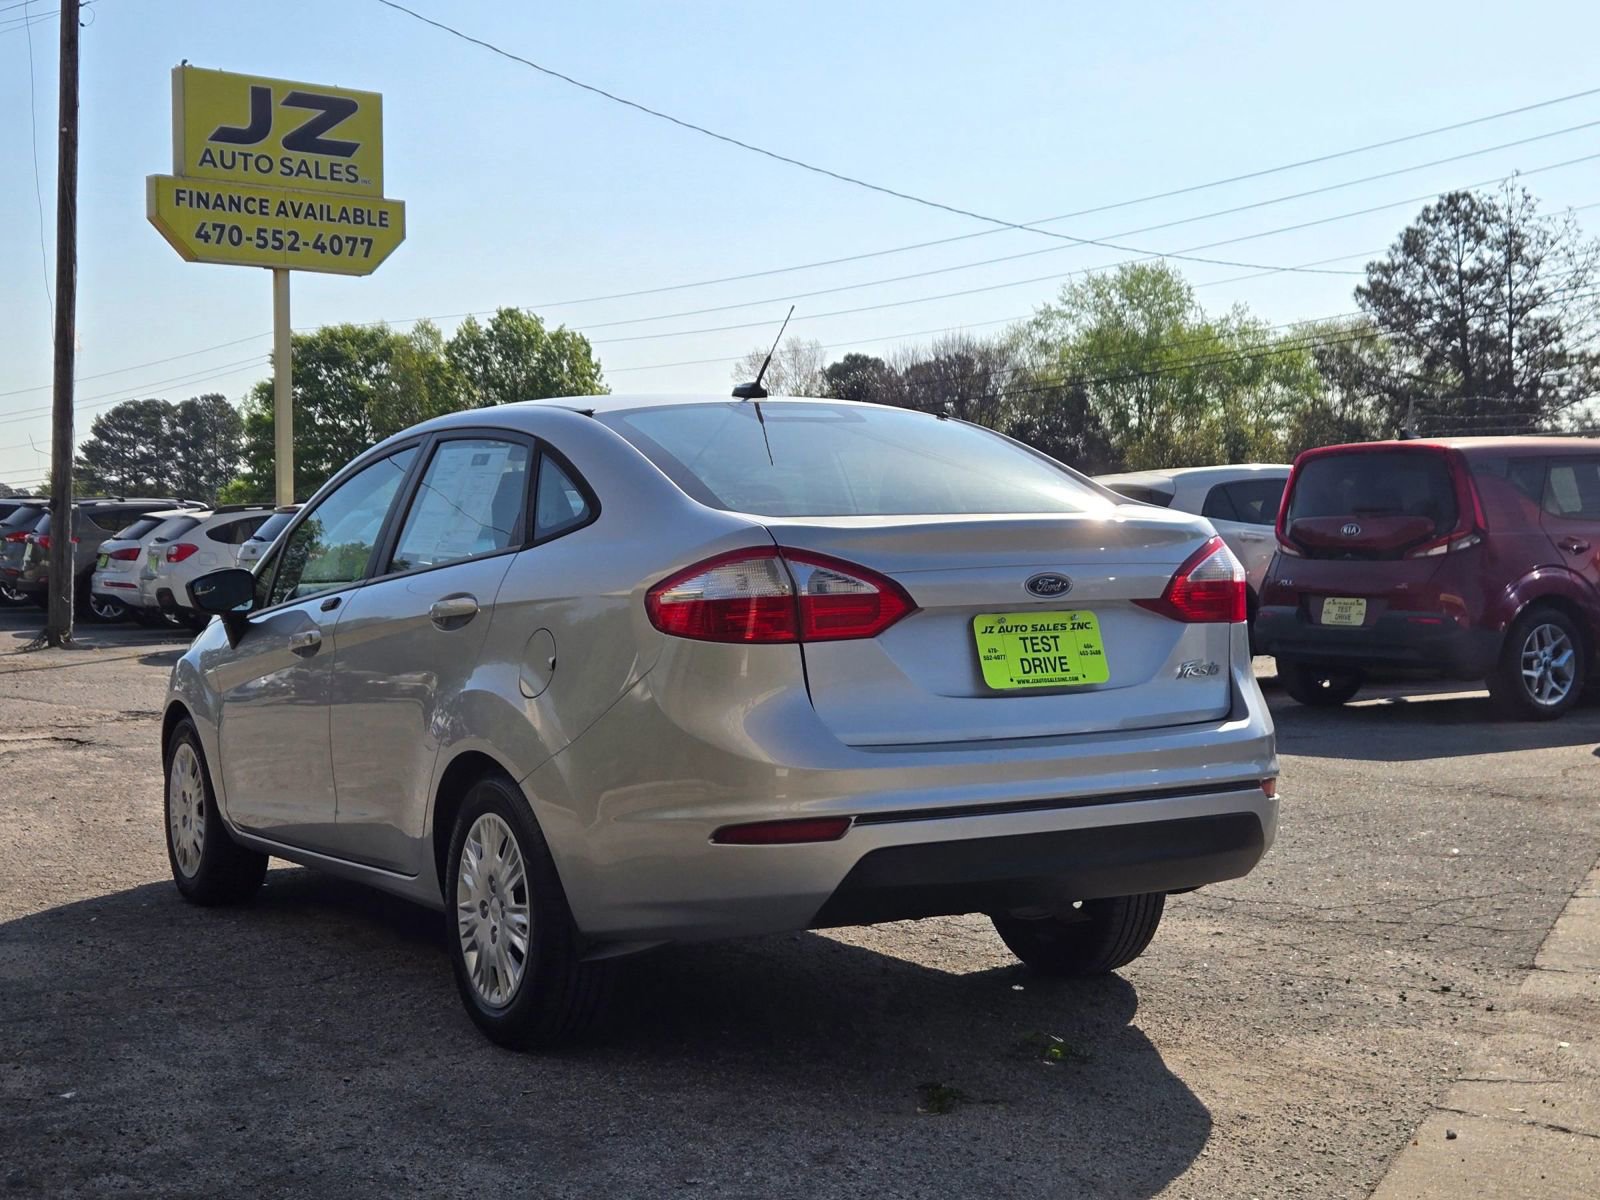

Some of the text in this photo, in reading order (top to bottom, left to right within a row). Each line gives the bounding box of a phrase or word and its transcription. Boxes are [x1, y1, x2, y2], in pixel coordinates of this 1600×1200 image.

[207, 85, 361, 158] JZ
[198, 147, 274, 174] AUTO
[279, 156, 359, 184] SALES
[174, 188, 390, 228] FINANCE AVAILABLE
[194, 222, 374, 258] 470-552-4077
[1342, 525, 1357, 534] KIA
[1036, 578, 1062, 592] Ford
[981, 621, 1093, 635] JZ AUTO SALES INC.
[1018, 635, 1060, 653] TEST
[1020, 655, 1070, 675] DRIVE
